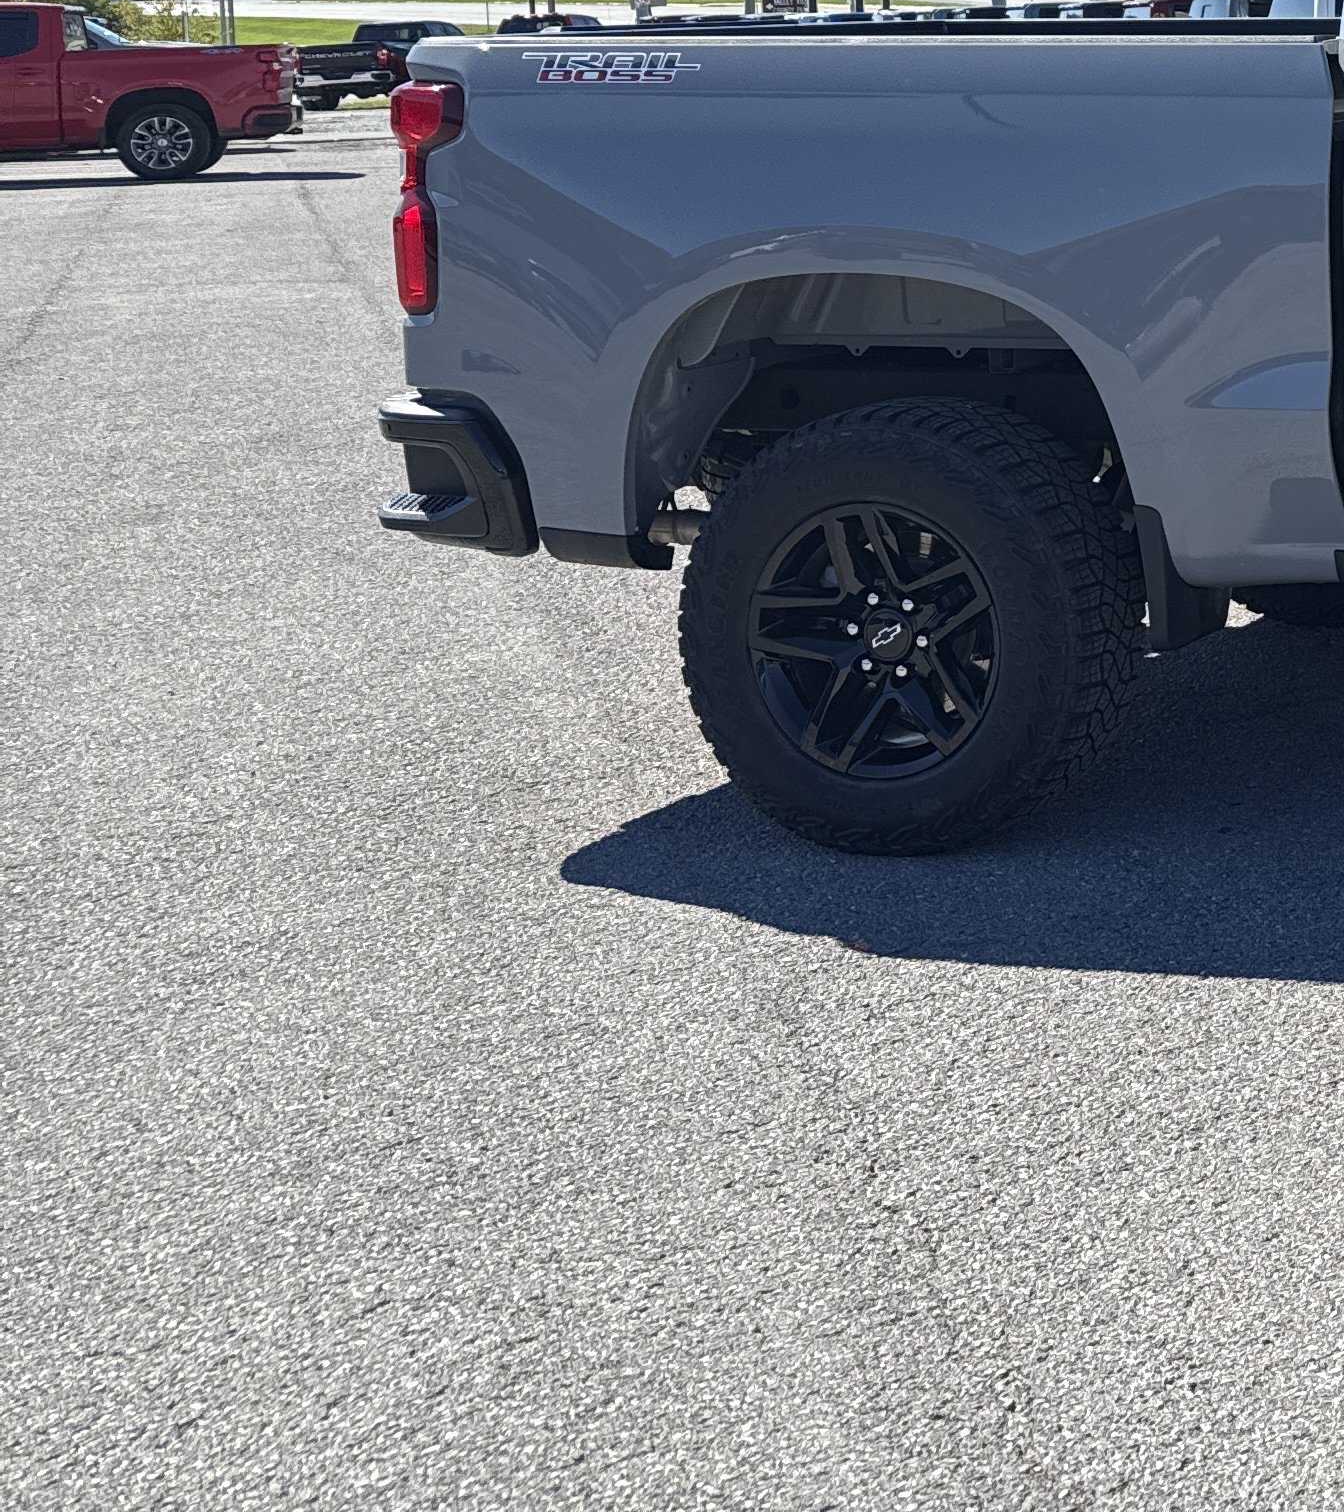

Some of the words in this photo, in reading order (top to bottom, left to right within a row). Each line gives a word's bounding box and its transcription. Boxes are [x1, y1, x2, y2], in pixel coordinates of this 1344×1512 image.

[304, 50, 371, 59] CHEVROLET
[521, 51, 702, 70] TRAIL
[536, 68, 677, 84] BOSS
